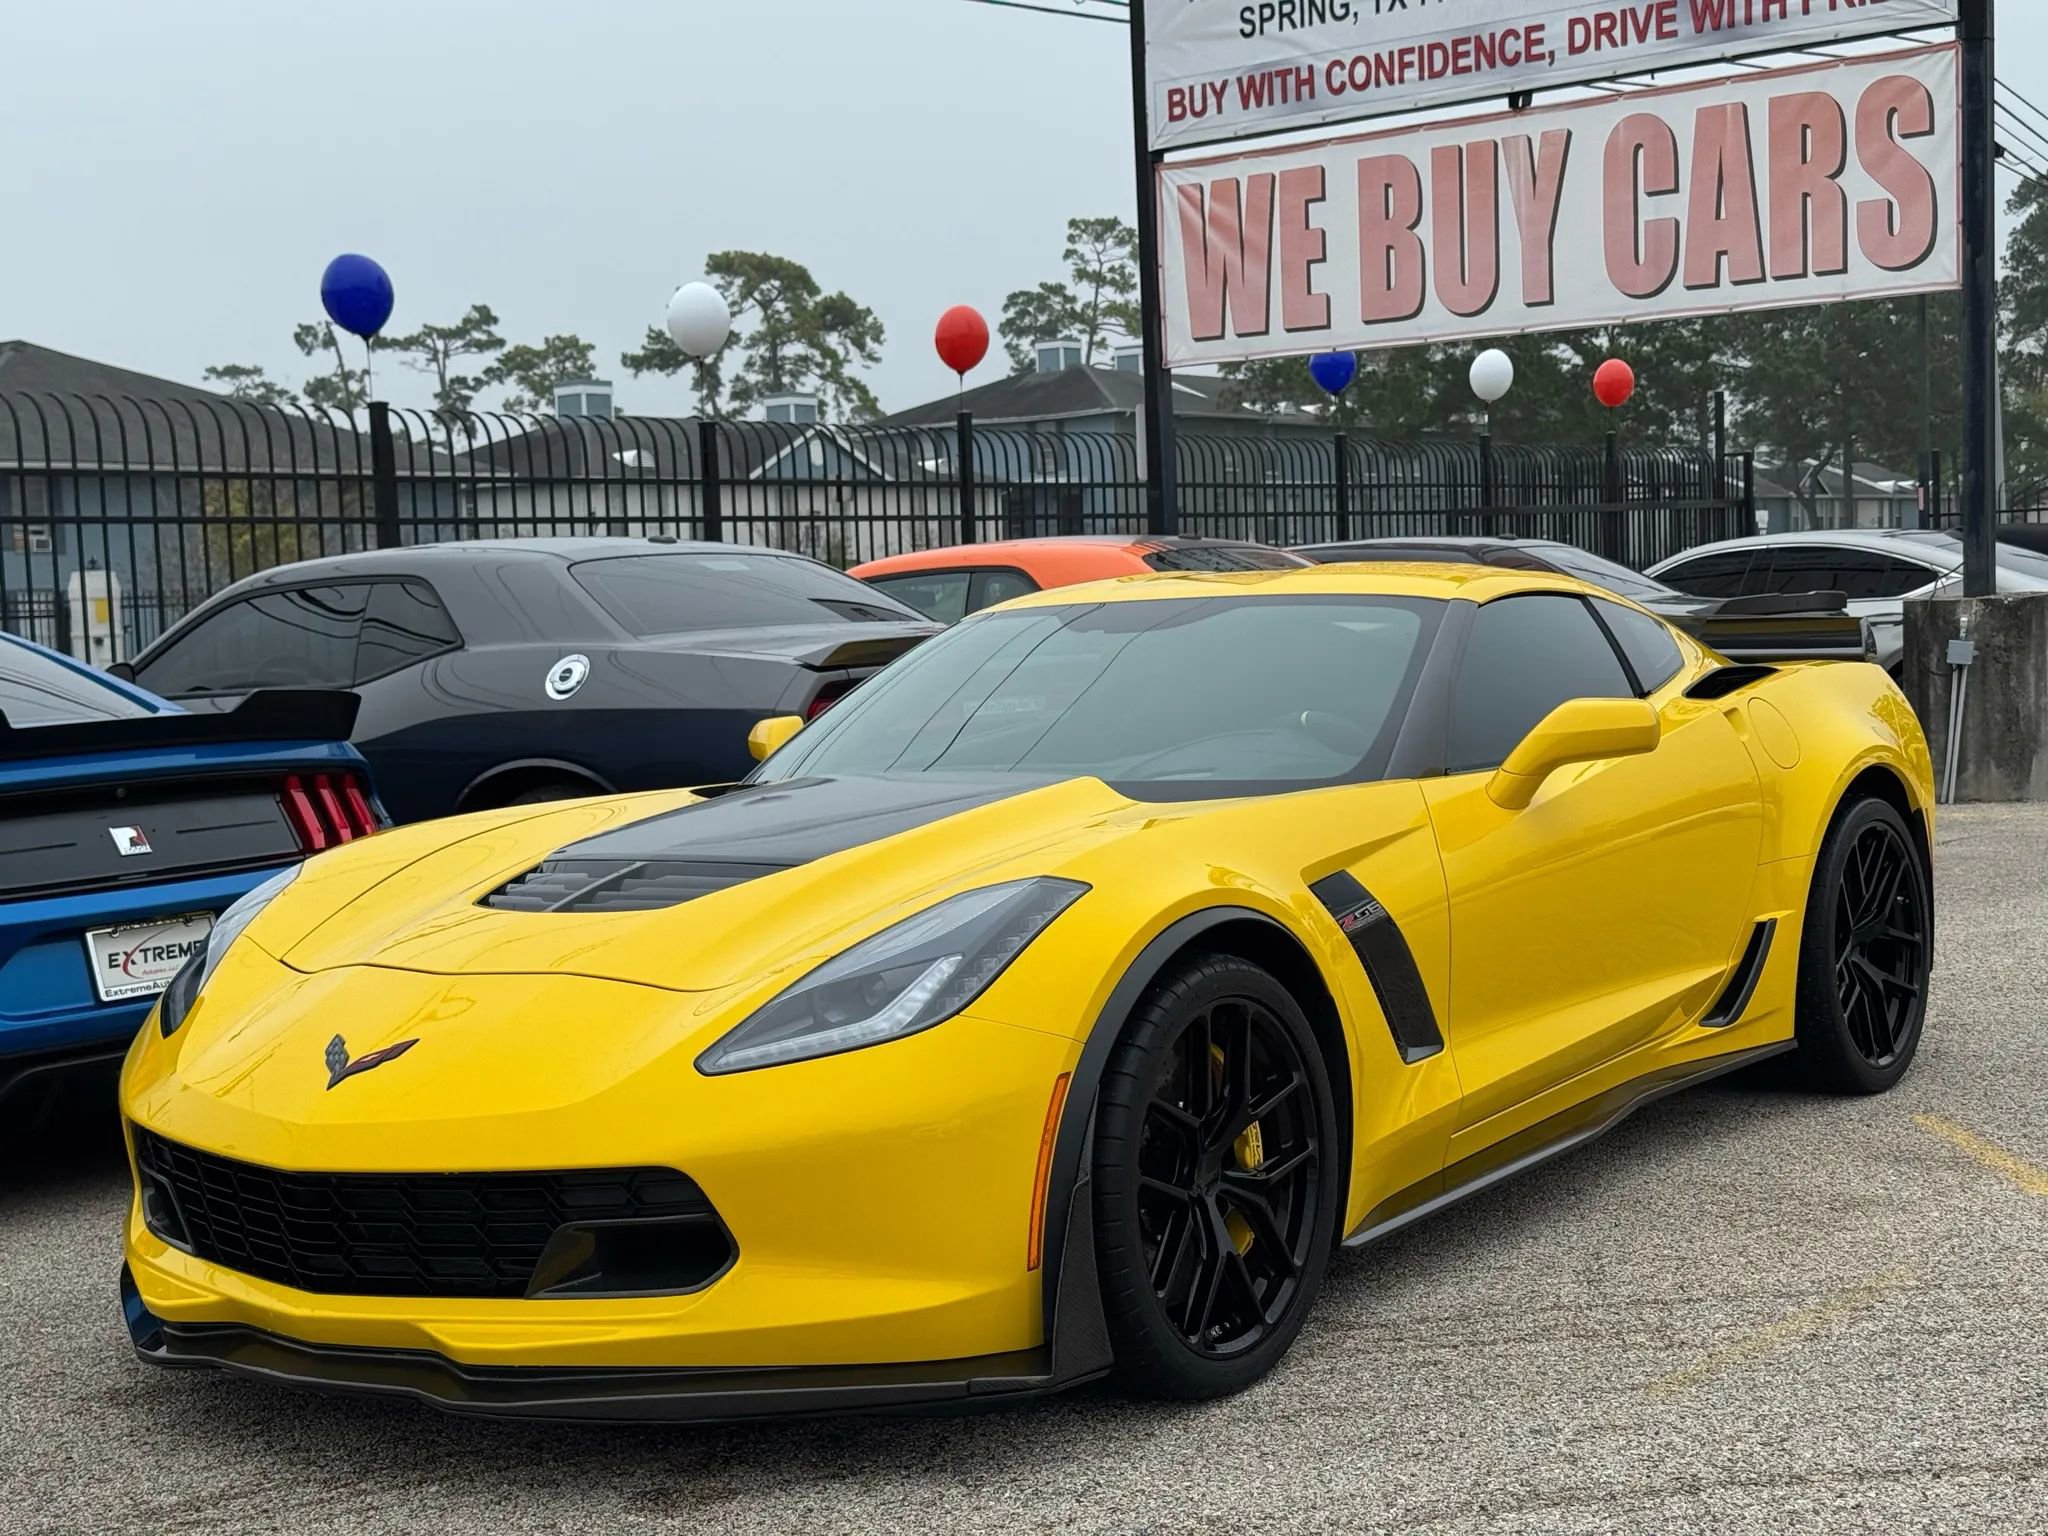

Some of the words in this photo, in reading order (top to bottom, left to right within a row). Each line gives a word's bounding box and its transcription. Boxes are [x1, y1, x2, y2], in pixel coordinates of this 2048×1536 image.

[1239, 0, 1359, 39] SPRING,
[1167, 78, 1230, 123] BUY
[1236, 64, 1316, 111] WITH
[1325, 24, 1556, 97] CONFIDENCE,
[1567, 1, 1679, 56] DRIVE
[1689, 0, 1788, 34] WITH
[1177, 165, 1332, 343] WE
[1357, 127, 1573, 326] BUY
[1602, 74, 1939, 300] CARS
[105, 980, 170, 998] ExtremeAu
